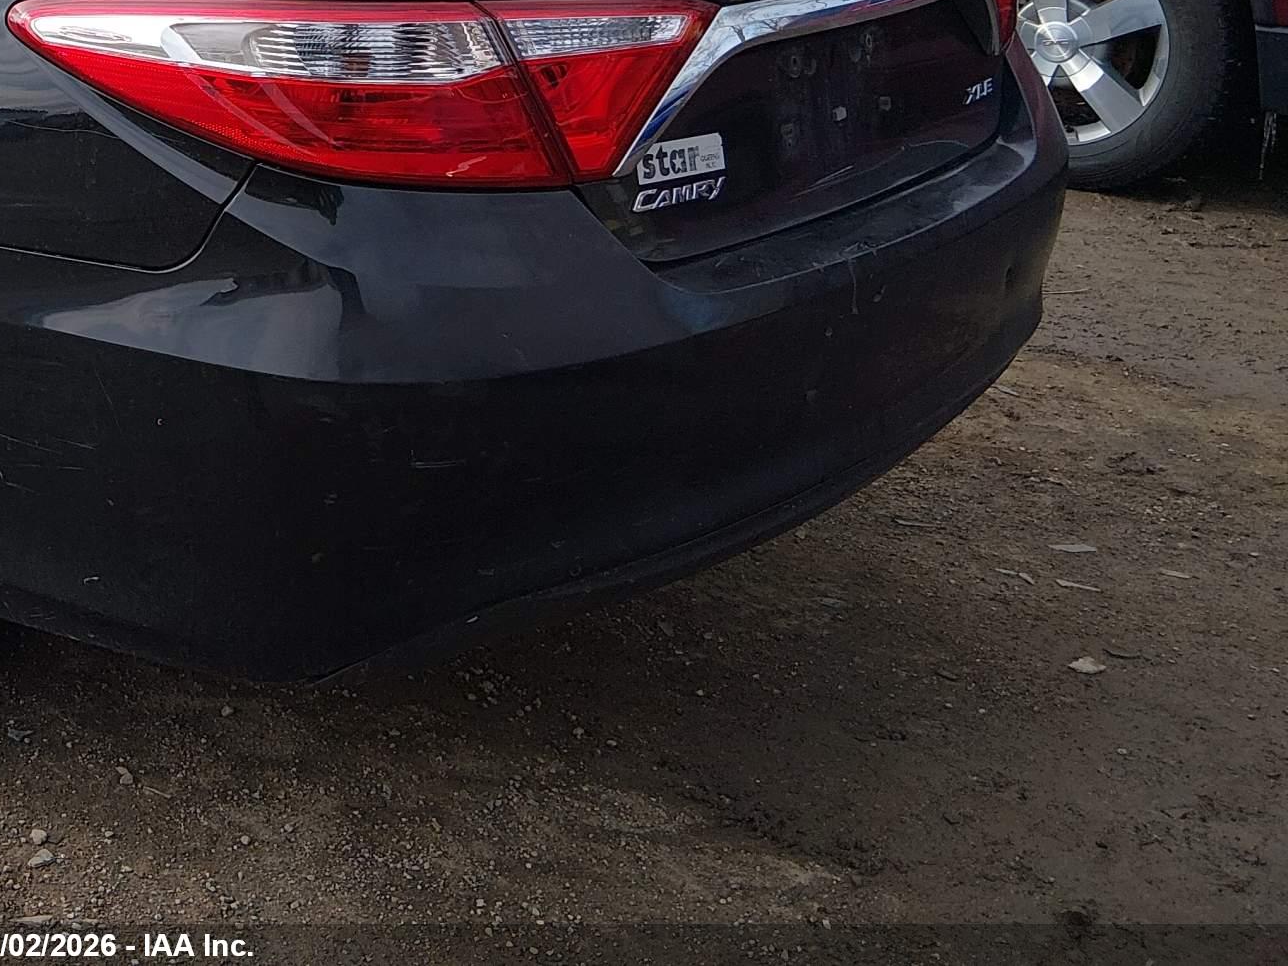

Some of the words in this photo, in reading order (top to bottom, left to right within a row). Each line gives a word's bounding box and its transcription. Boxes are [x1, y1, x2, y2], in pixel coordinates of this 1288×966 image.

[963, 77, 993, 105] XLE
[642, 145, 699, 180] star
[632, 176, 726, 213] CAMRY
